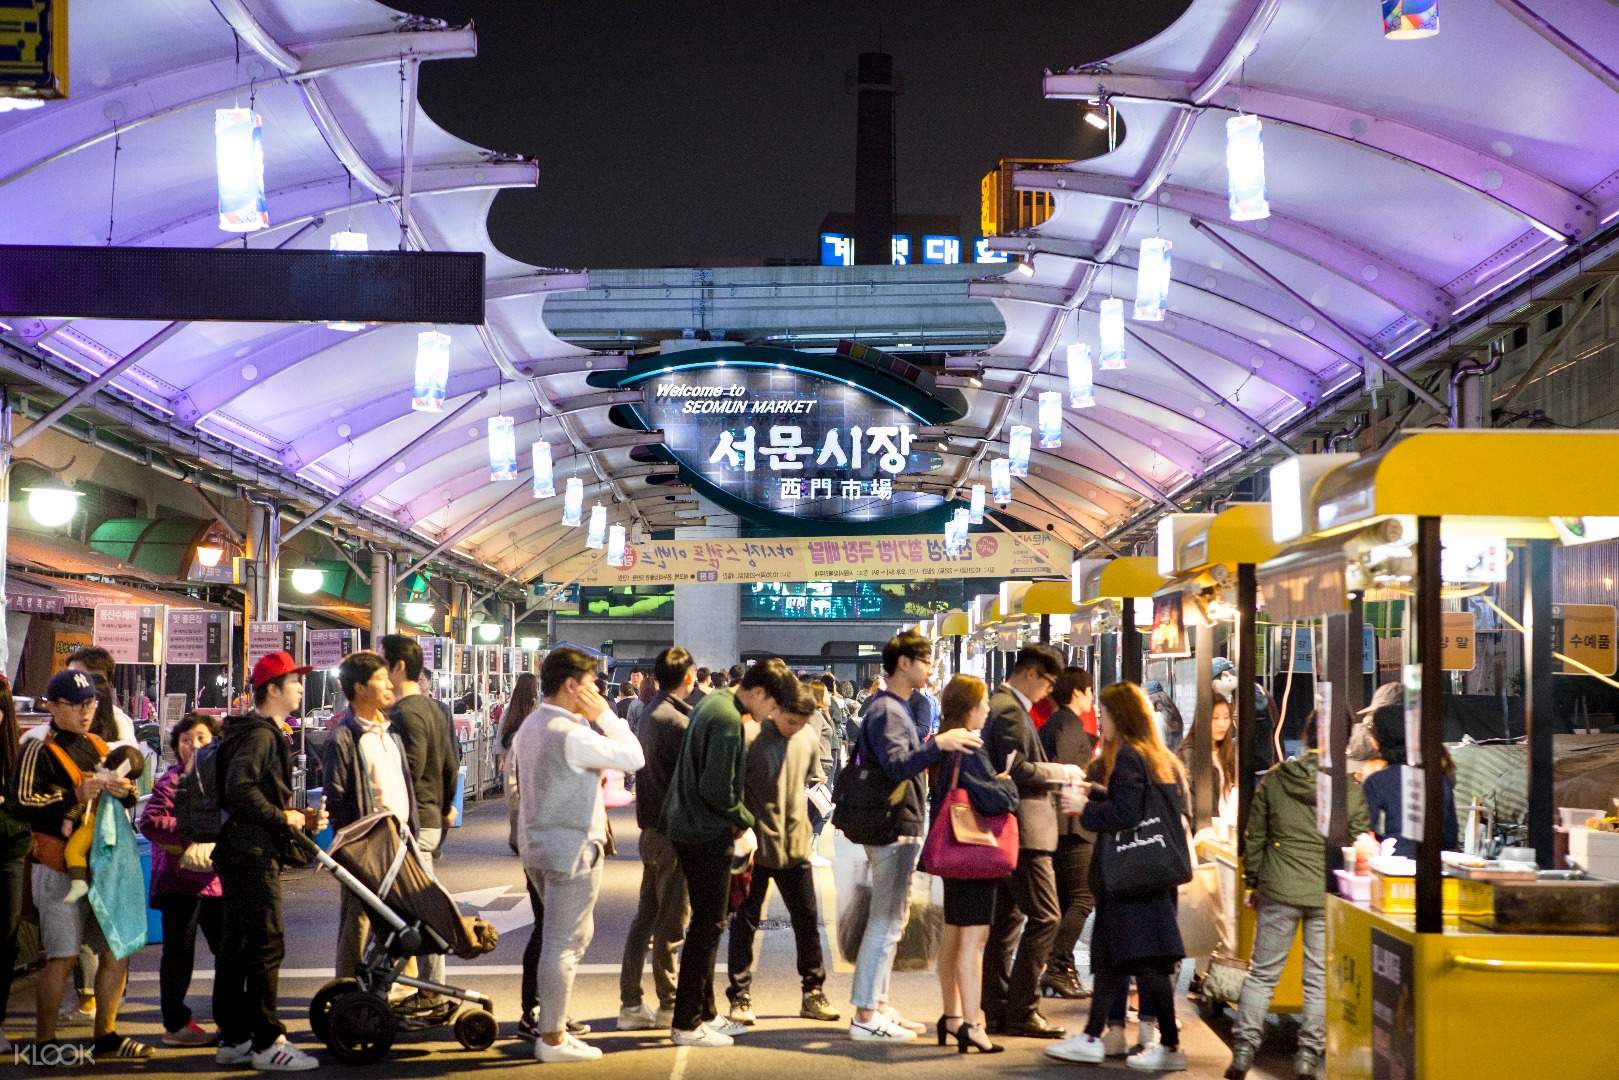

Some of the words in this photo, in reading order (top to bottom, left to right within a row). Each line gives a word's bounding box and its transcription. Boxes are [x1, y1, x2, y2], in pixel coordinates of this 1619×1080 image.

[656, 383, 723, 397] Welcome
[729, 384, 745, 397] to
[682, 400, 748, 414] SEOMUN
[751, 400, 817, 414] MARKET
[709, 424, 917, 473] 서문시장
[781, 478, 893, 500] 西門市場
[1569, 633, 1611, 650] 수예품
